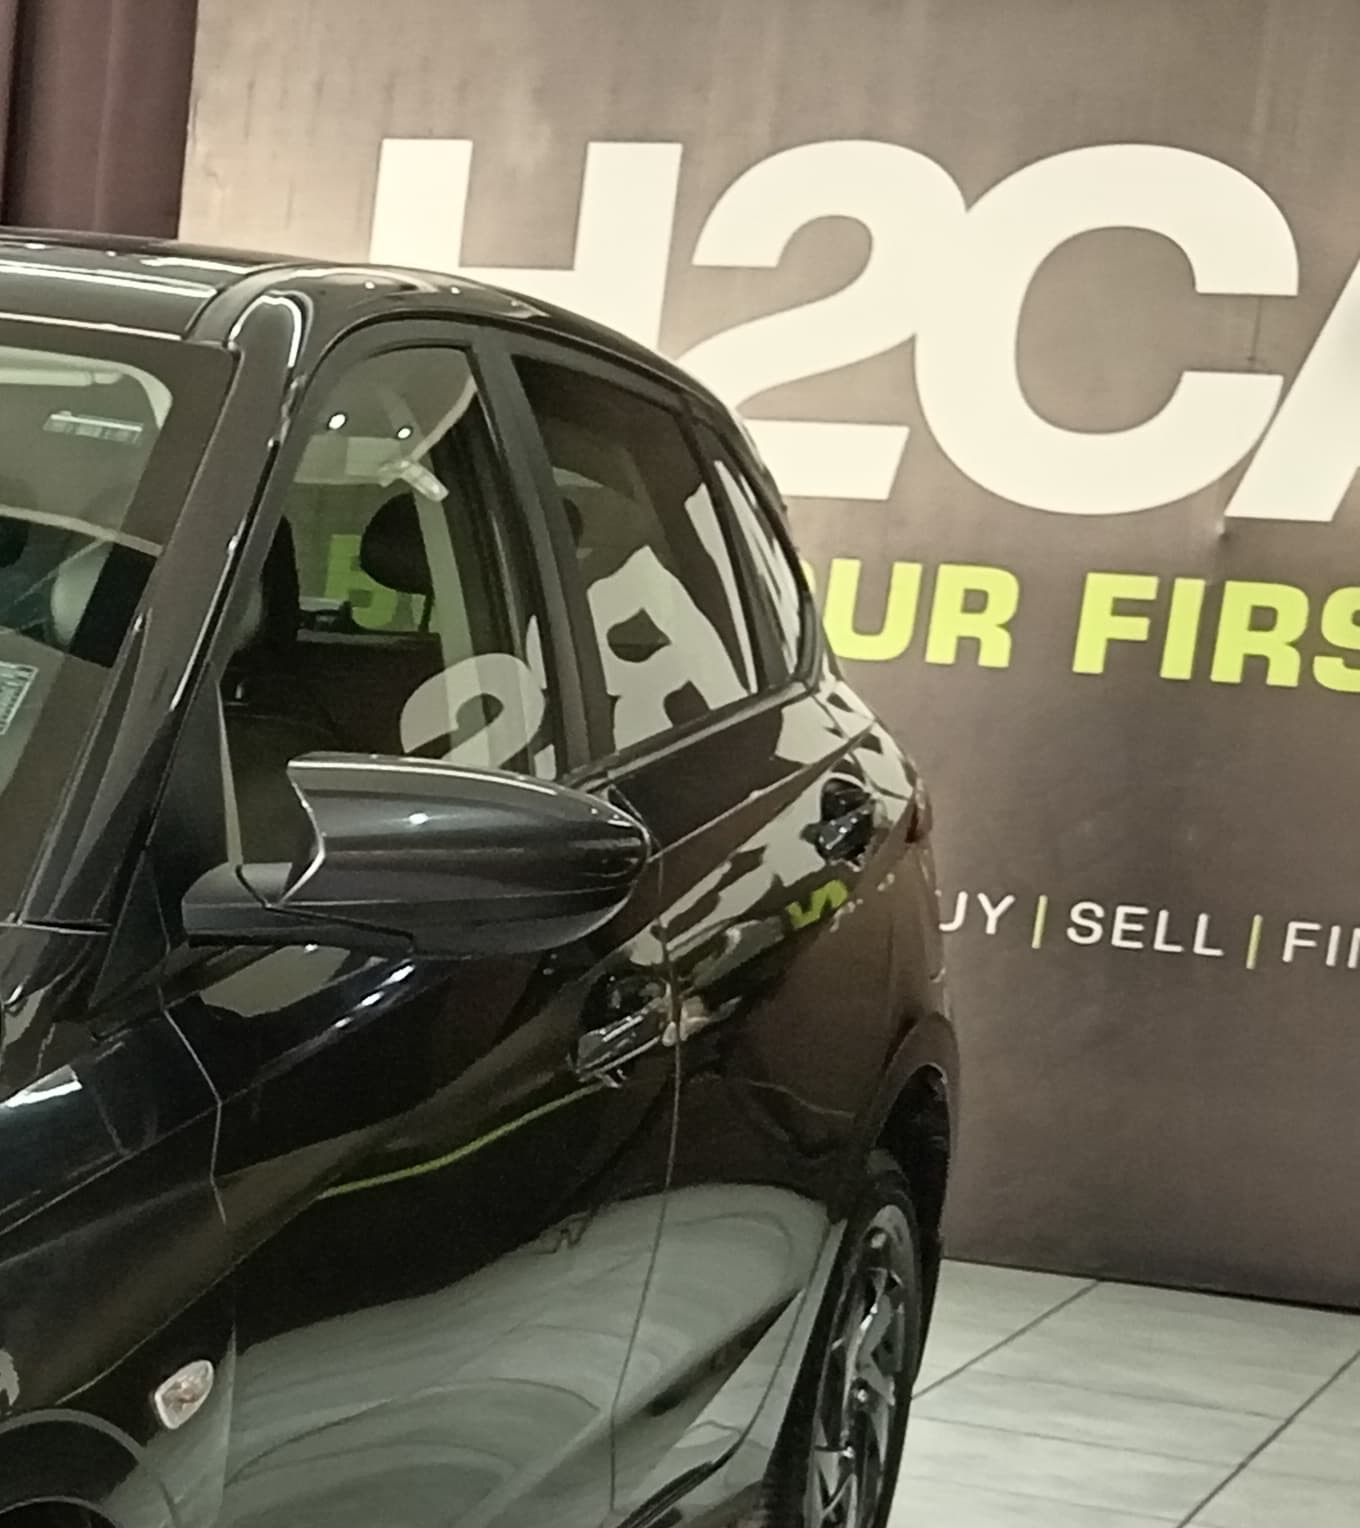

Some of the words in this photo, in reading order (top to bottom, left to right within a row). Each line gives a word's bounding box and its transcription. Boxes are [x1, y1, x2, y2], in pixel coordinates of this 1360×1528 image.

[801, 557, 1020, 669] UR
[938, 890, 1016, 935] UY
[1066, 900, 1224, 957] SELL
